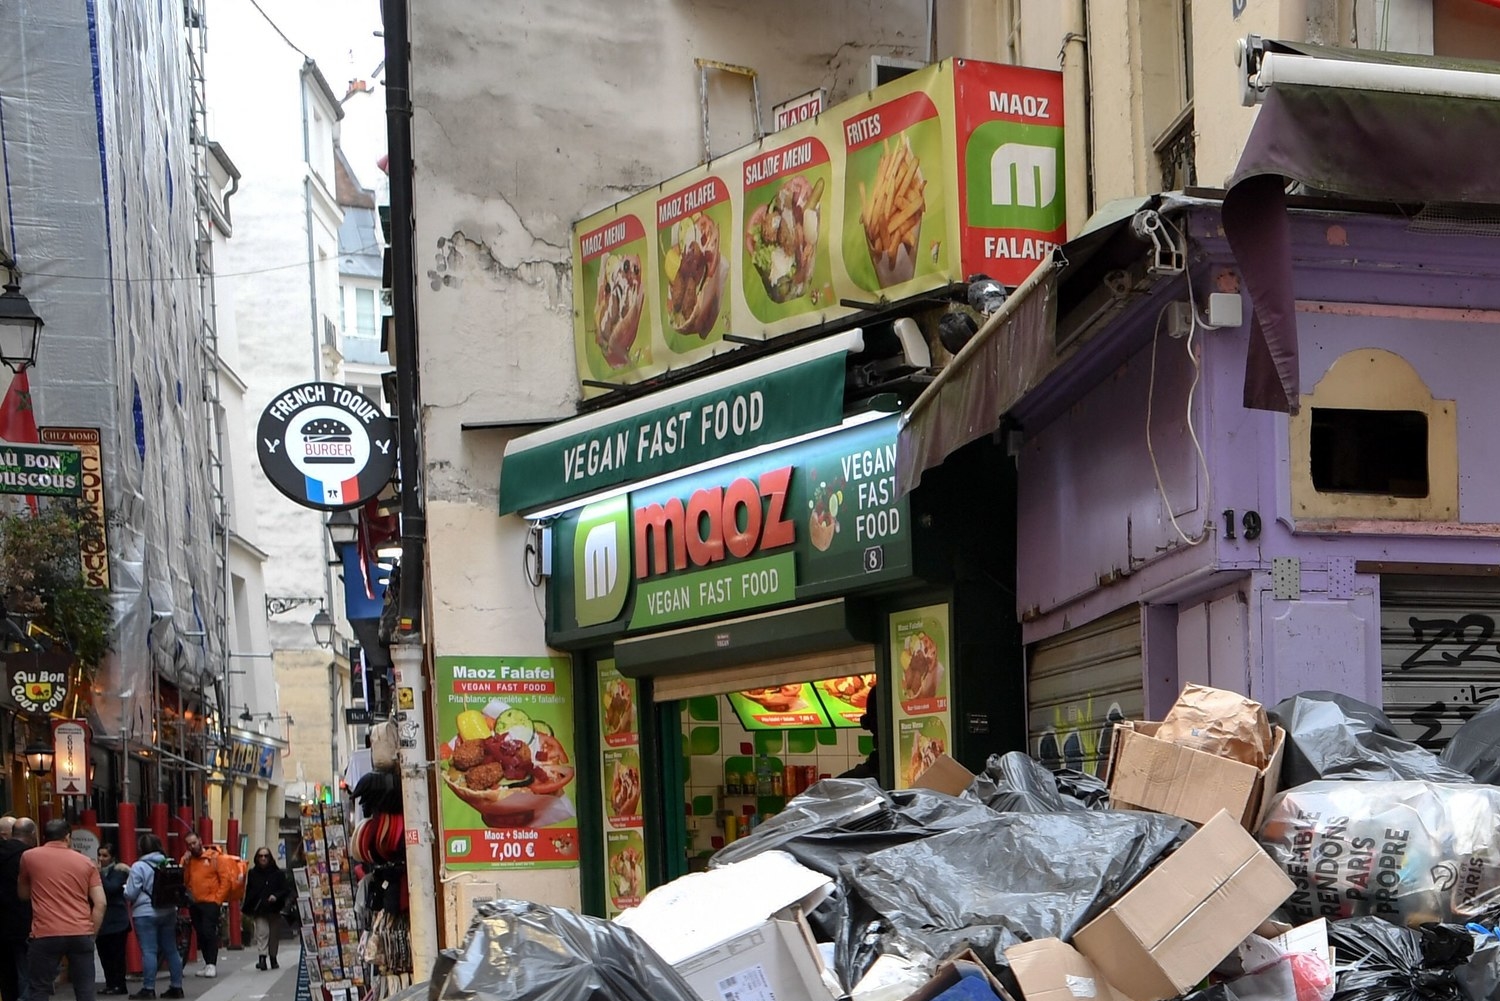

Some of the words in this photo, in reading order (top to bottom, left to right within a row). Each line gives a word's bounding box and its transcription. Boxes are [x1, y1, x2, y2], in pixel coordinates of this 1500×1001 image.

[778, 99, 822, 127] MAOZ
[988, 90, 1050, 119] MAOZ
[846, 113, 881, 147] FRITES
[744, 153, 780, 187] SALADE
[781, 141, 813, 174] MENU
[658, 199, 683, 223] MAOZ
[683, 186, 717, 219] FALAFEL
[581, 233, 603, 255] MAOZ
[603, 227, 627, 249] MENU
[984, 236, 1057, 260] FALAFE
[269, 385, 327, 422] FRENCH
[332, 387, 380, 424] TOQUE
[44, 431, 67, 441] CHEZ
[68, 431, 98, 442] MOMO
[305, 443, 353, 456] BURGER
[563, 430, 632, 484] VEGAN
[637, 411, 692, 463] FAST
[699, 390, 765, 445] FOOD
[24, 453, 61, 470] BON
[841, 444, 898, 483] VEGAN
[858, 476, 898, 512] FAST
[81, 456, 107, 588] COUSOUS
[634, 465, 796, 580] maoz
[856, 507, 901, 543] FOOD
[1221, 509, 1262, 542] 19
[869, 550, 878, 568] 8
[647, 590, 691, 617] VEGAN
[699, 577, 733, 607] FAST
[742, 568, 779, 599] FOOD
[13, 671, 36, 685] Au
[39, 671, 65, 683] Bon
[453, 666, 497, 679] Maoz
[501, 666, 555, 680] Falafel
[461, 683, 491, 692] VEGAN
[496, 683, 518, 692] FAST
[523, 683, 547, 692] FOOD
[448, 694, 463, 704] Pita
[465, 694, 487, 704] blanc
[488, 694, 523, 705] complète
[531, 695, 537, 704] 5
[484, 830, 505, 841] Maoz
[512, 830, 539, 840] Salade
[489, 842, 521, 861] 7,00
[525, 842, 535, 858] €
[1286, 809, 1322, 919] ENSEMBLE
[1315, 814, 1351, 918] RENDONS
[1345, 836, 1377, 901] PARIS
[1376, 828, 1410, 915] PROPRE
[1463, 856, 1485, 906] PARIS
